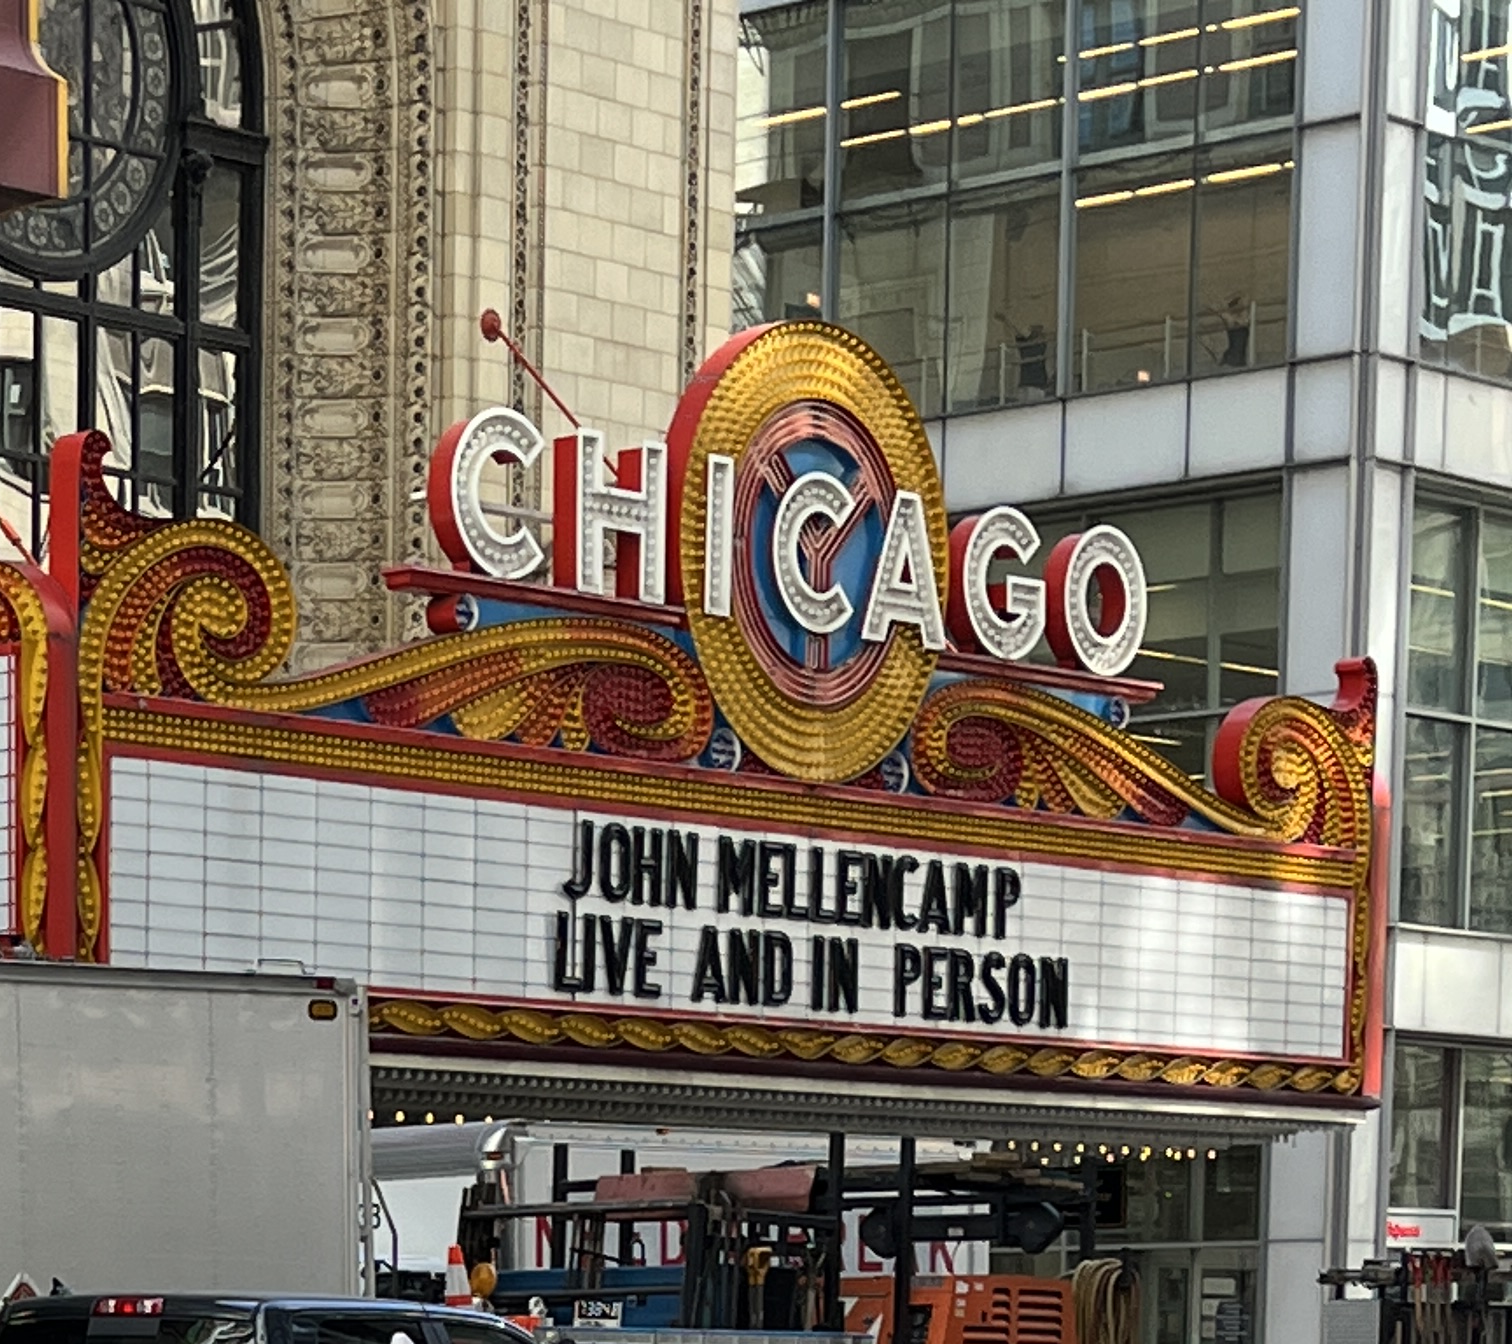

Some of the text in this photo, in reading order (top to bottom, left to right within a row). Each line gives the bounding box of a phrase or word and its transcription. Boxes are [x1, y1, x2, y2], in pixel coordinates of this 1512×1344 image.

[434, 406, 1148, 677] CHICAGO
[563, 818, 1021, 940] JOHN MELLENCAMP
[554, 910, 1069, 1028] LIVE AND IN PERSON
